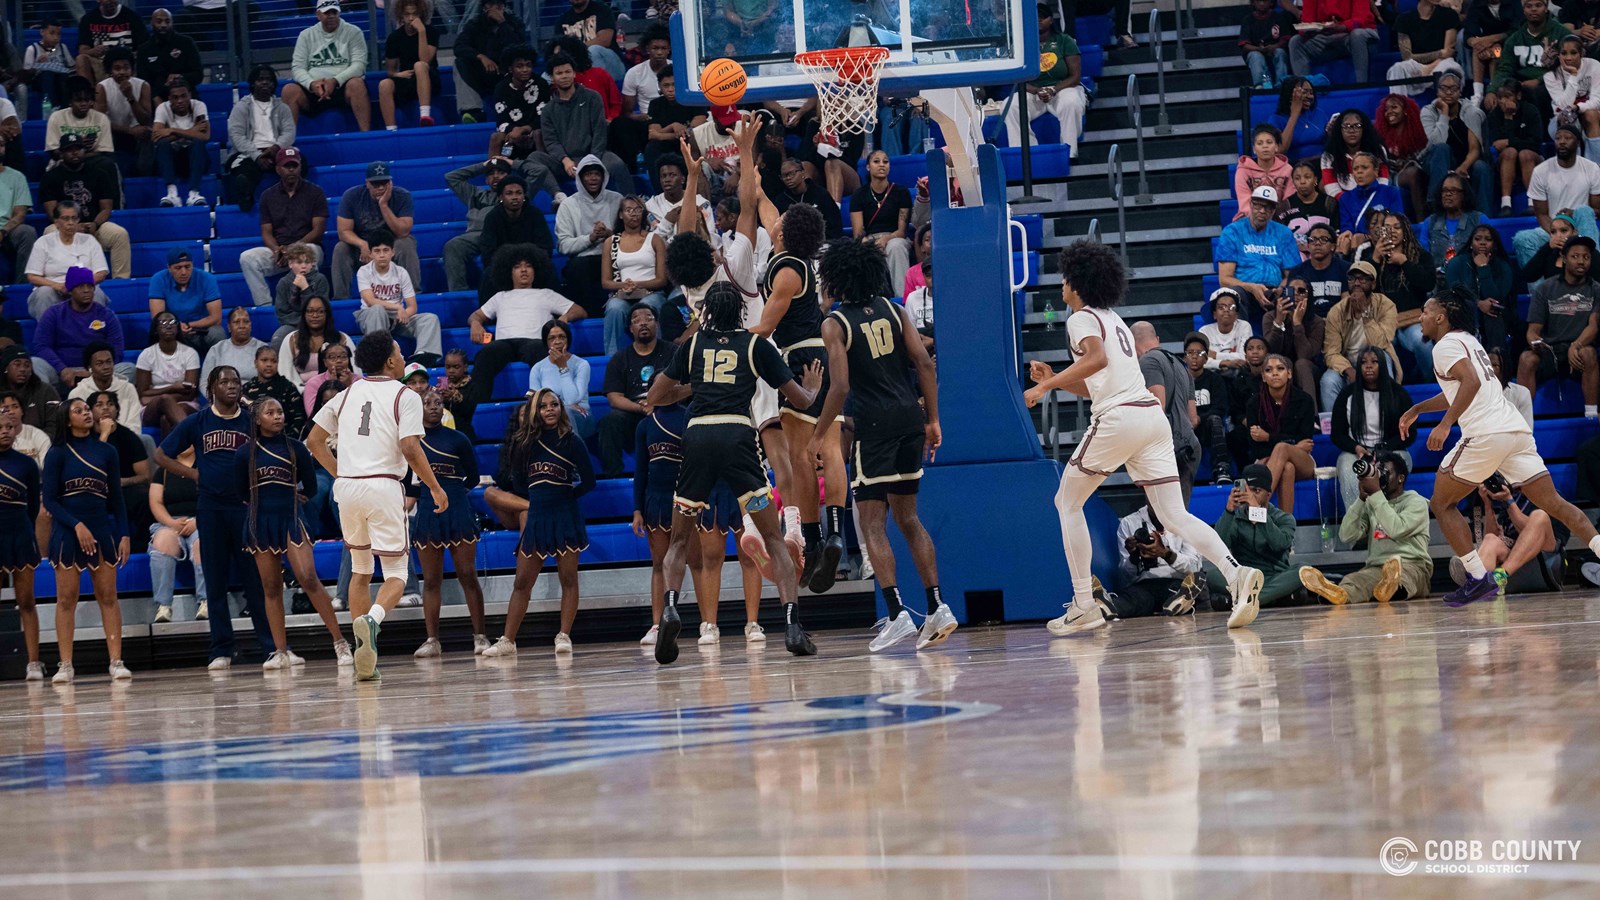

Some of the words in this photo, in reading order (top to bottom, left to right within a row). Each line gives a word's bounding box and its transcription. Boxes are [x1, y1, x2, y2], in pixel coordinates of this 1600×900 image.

[719, 75, 745, 91] Wilson
[1263, 189, 1271, 198] C
[859, 318, 895, 360] 10
[1115, 325, 1133, 358] 0
[703, 349, 738, 385] 12
[357, 401, 372, 437] 1
